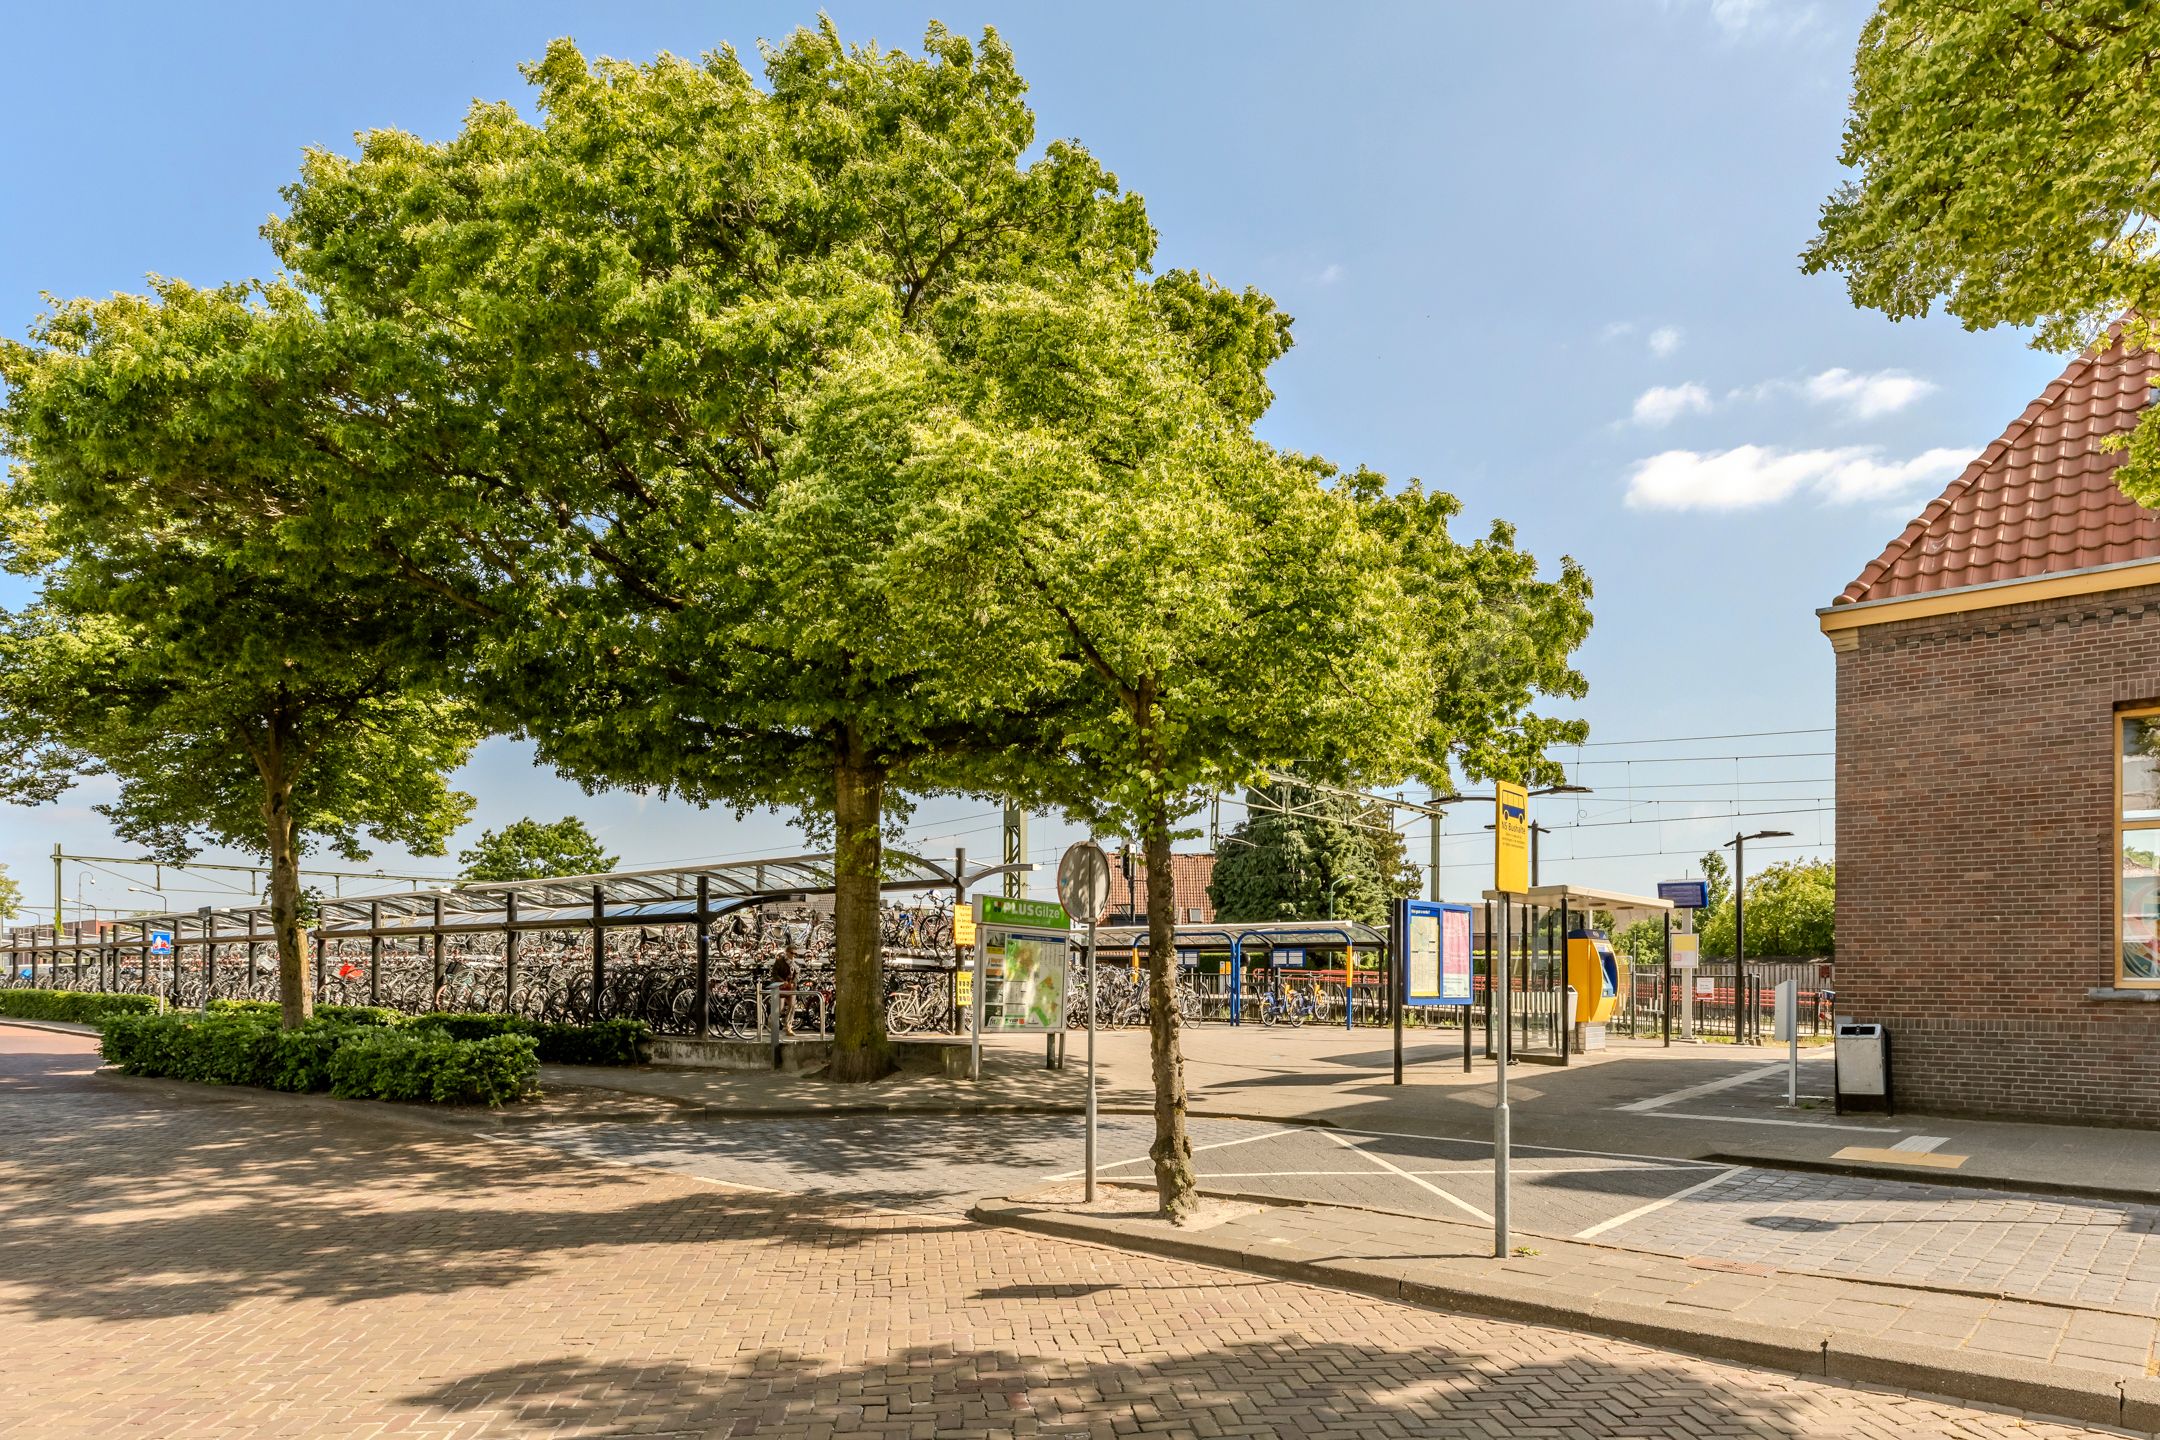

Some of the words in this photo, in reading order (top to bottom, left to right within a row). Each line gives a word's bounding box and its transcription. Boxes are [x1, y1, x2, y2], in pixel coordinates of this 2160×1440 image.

[1508, 822, 1526, 835] Bushalte
[1003, 902, 1034, 916] PLUS
[1035, 905, 1060, 919] Gilze
